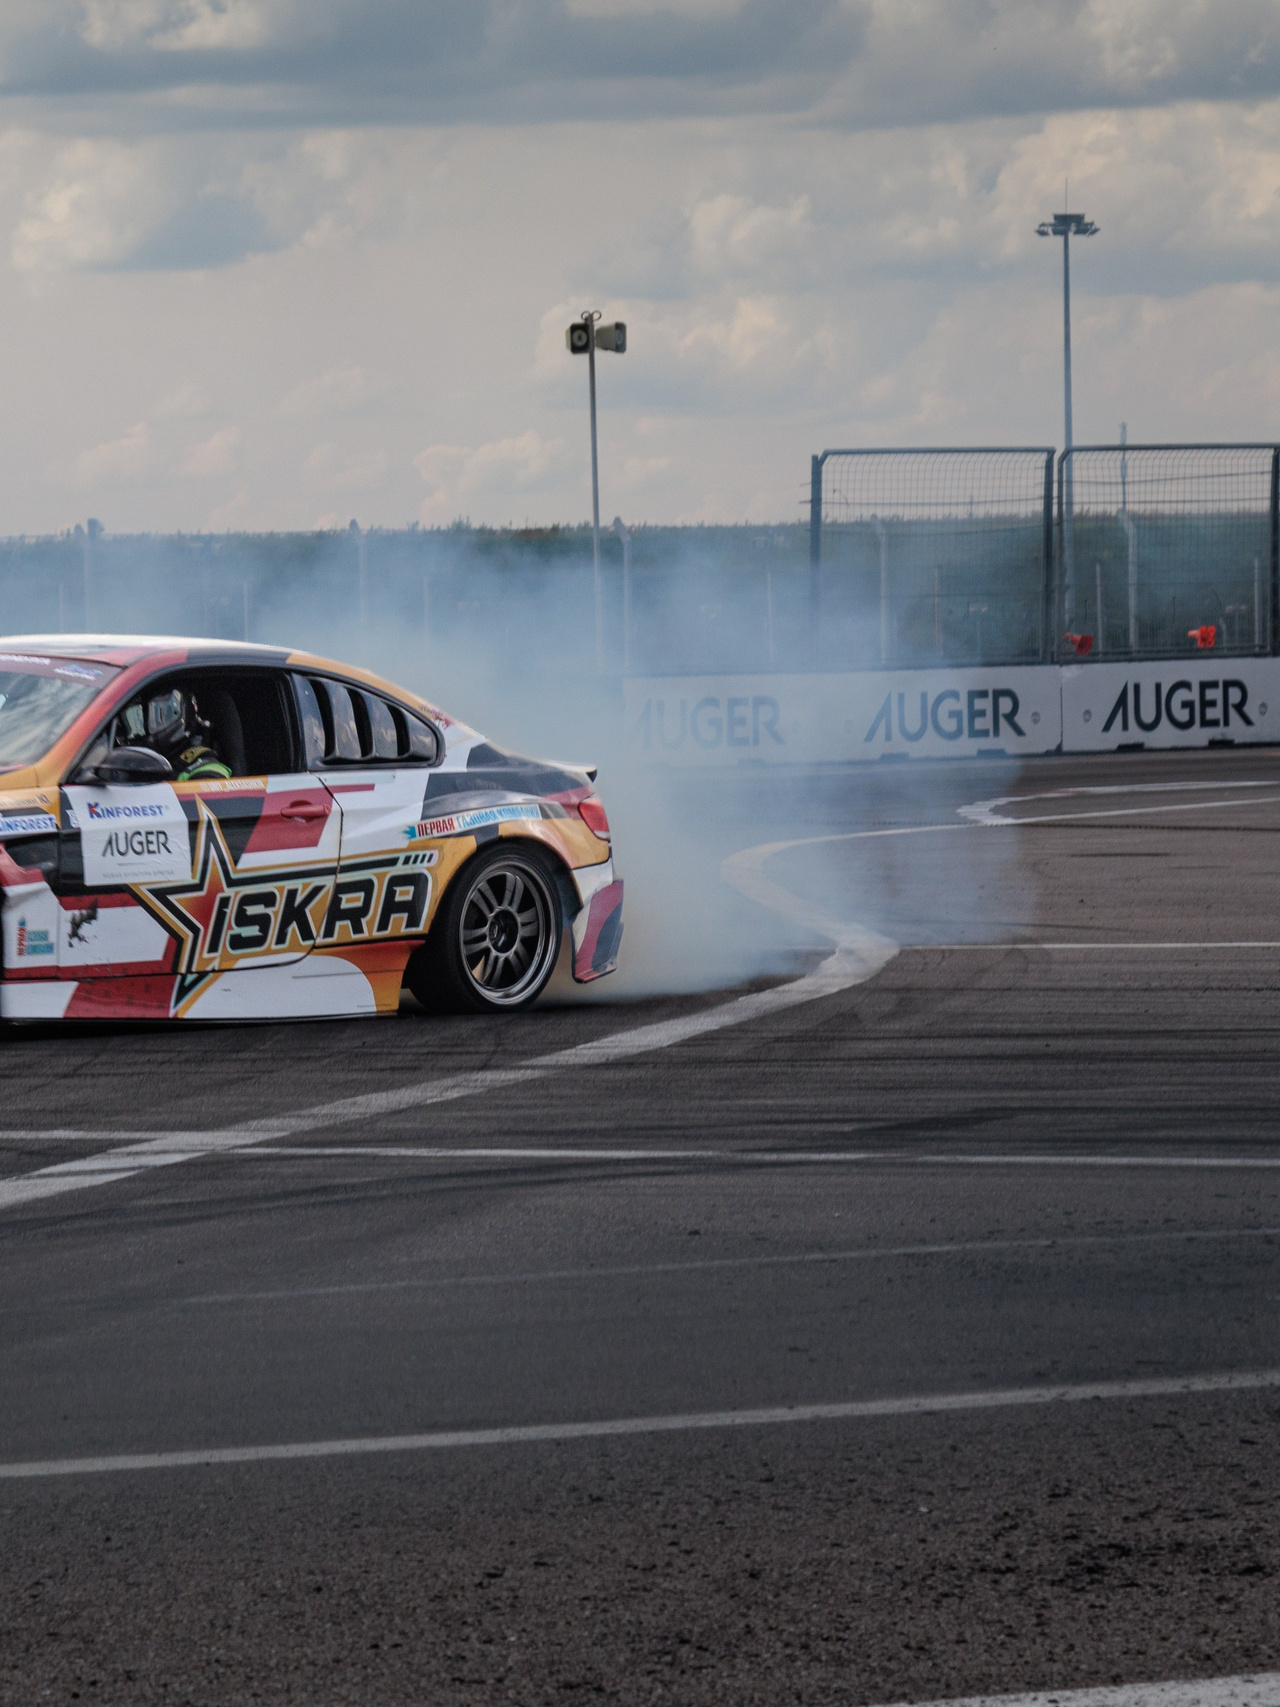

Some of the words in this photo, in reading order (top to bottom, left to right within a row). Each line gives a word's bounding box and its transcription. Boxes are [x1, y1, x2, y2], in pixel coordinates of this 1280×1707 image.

[630, 696, 787, 750] AUGER
[863, 688, 1027, 743] AUGER
[1101, 679, 1255, 733] AUGER
[86, 802, 163, 819] KINFOREST
[417, 817, 455, 837] ПЕРВАЯ
[457, 810, 498, 829] ГАЗОВАЯ
[101, 829, 173, 857] AUGER
[205, 870, 431, 957] ISKRA
